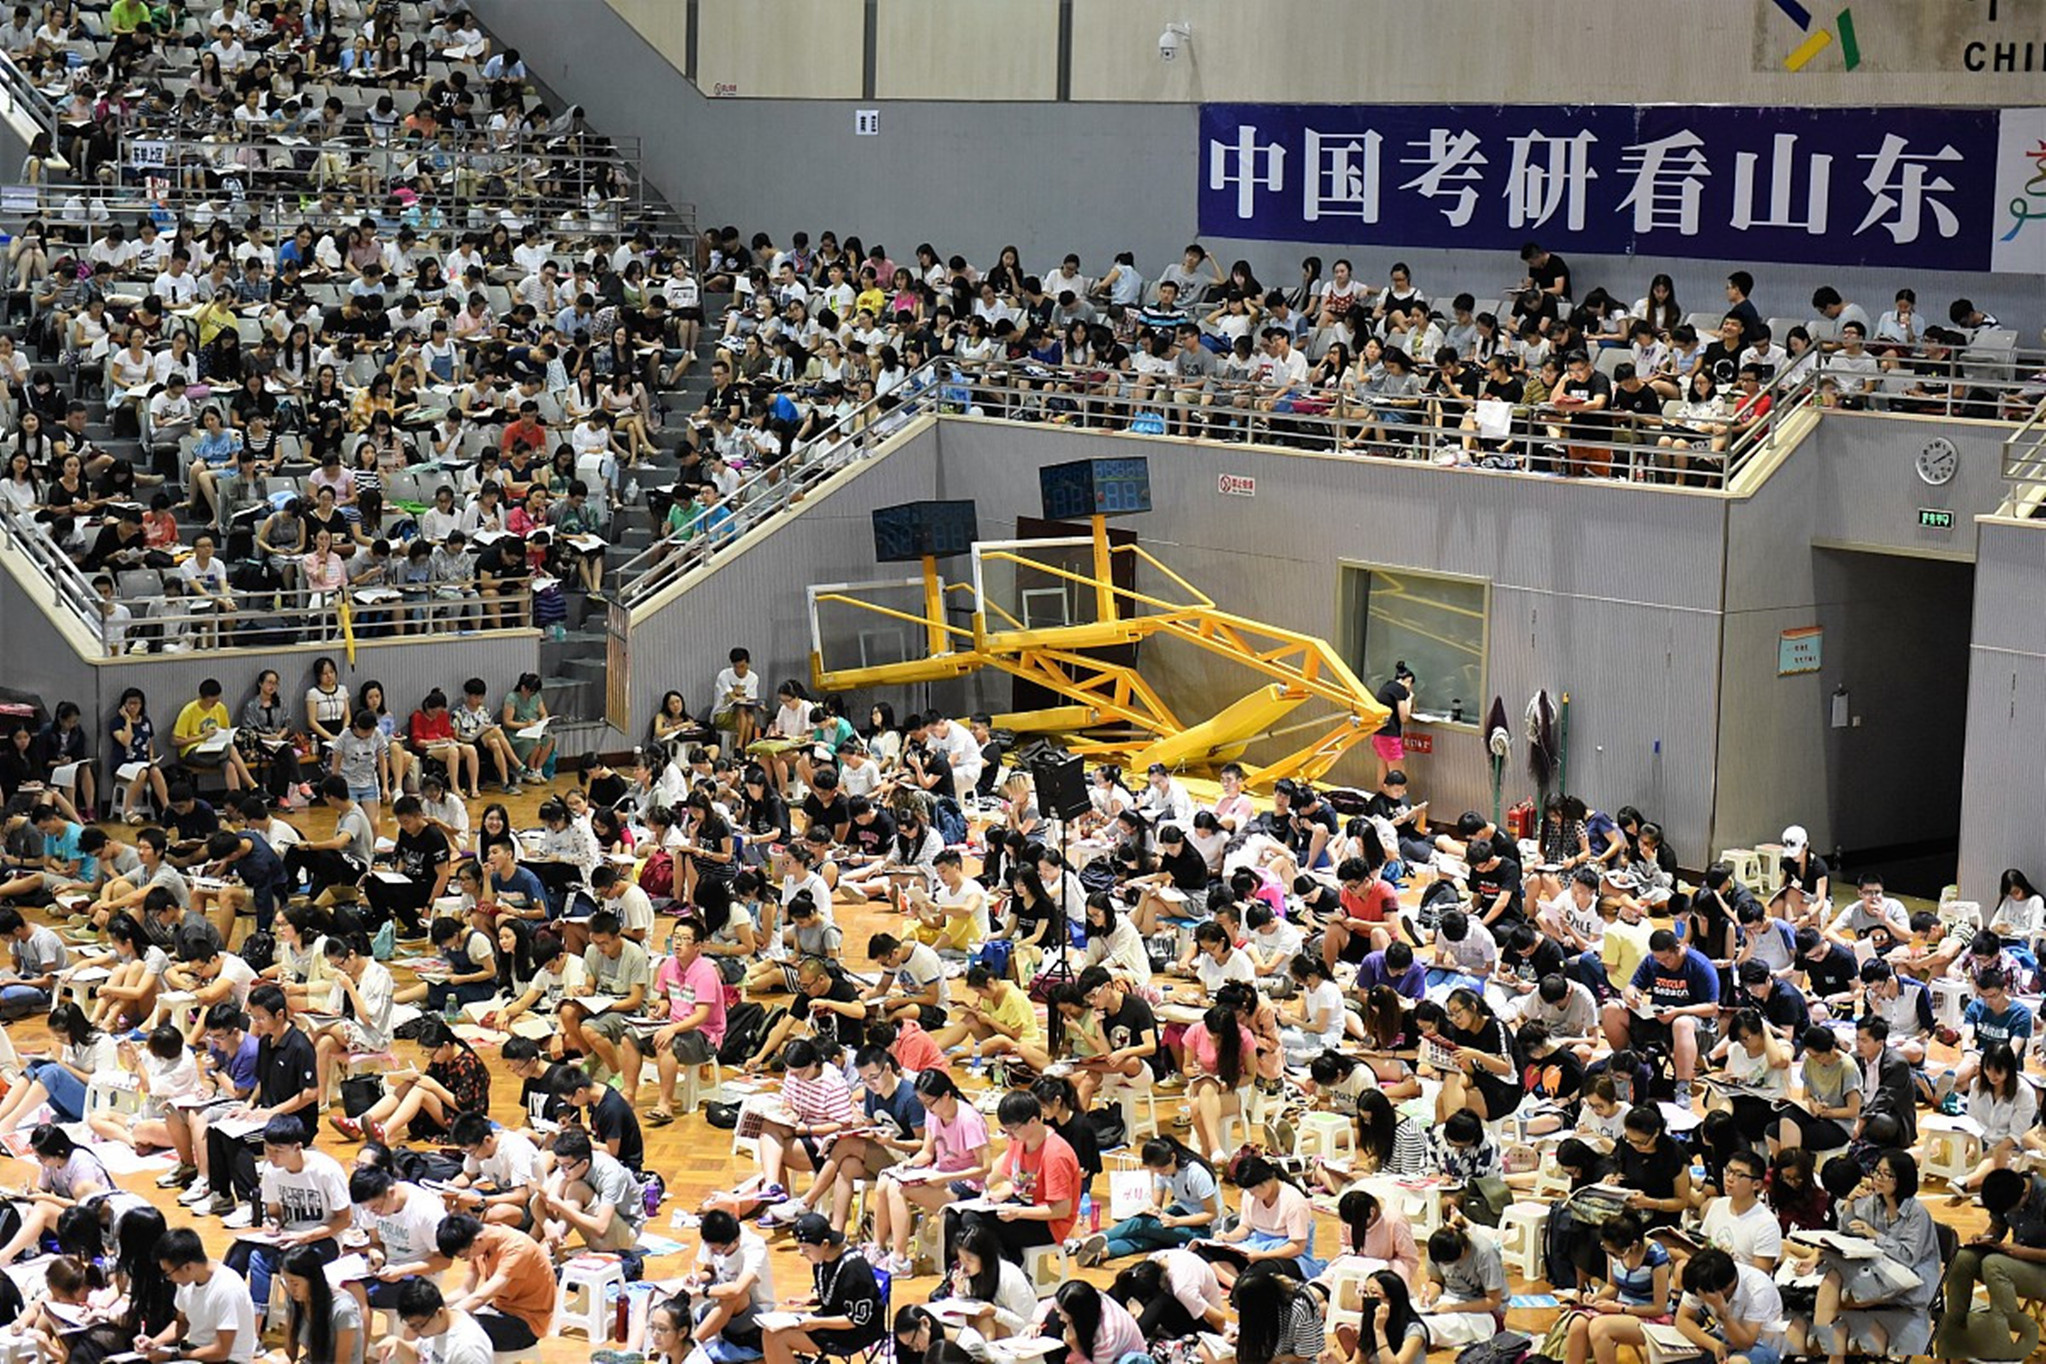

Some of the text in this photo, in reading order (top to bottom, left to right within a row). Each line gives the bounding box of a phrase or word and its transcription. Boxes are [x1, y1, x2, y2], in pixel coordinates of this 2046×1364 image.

[1964, 42, 2046, 72] CHI
[1210, 125, 1964, 244] 中国考研看山东
